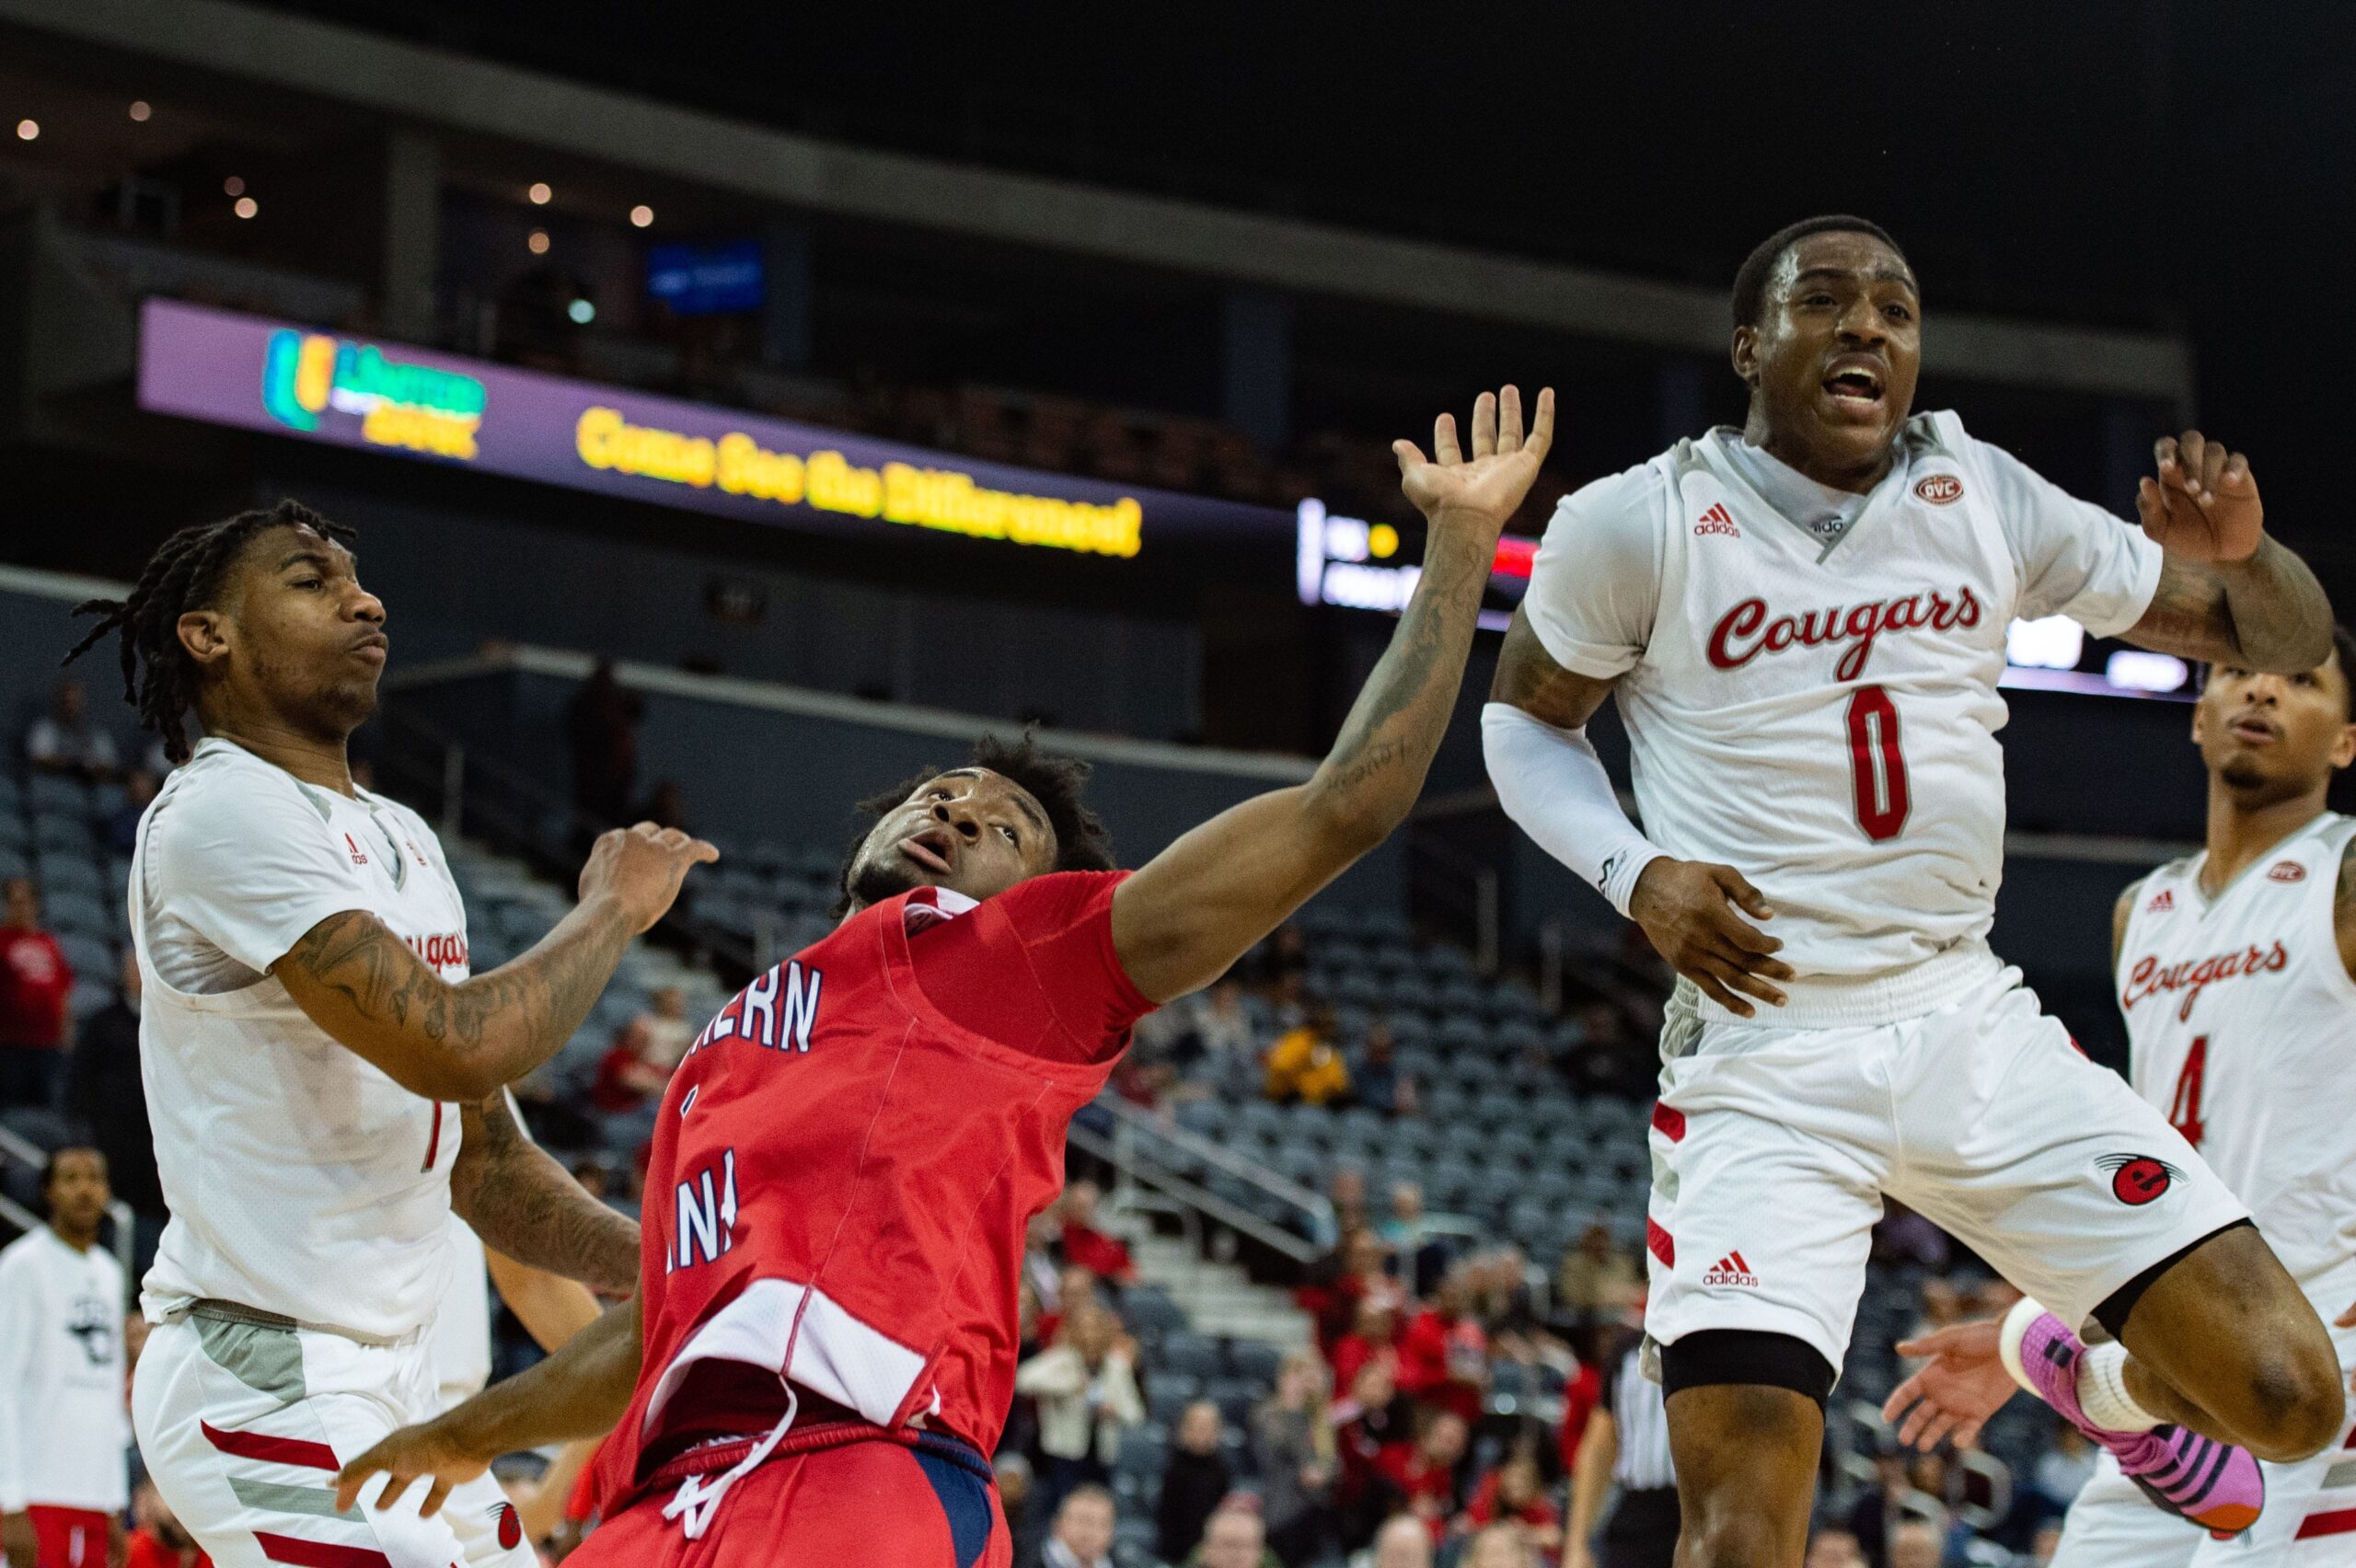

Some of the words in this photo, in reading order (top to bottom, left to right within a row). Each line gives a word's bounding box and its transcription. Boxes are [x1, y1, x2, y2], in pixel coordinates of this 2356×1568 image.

[1694, 522, 1740, 538] adidas
[1924, 482, 1957, 498] OVC
[1706, 585, 1982, 684] Cougars
[1843, 683, 1913, 845] 0
[2122, 940, 2290, 1024] Cougars
[2167, 1033, 2209, 1149] 4
[1703, 1271, 1759, 1287] adidas
